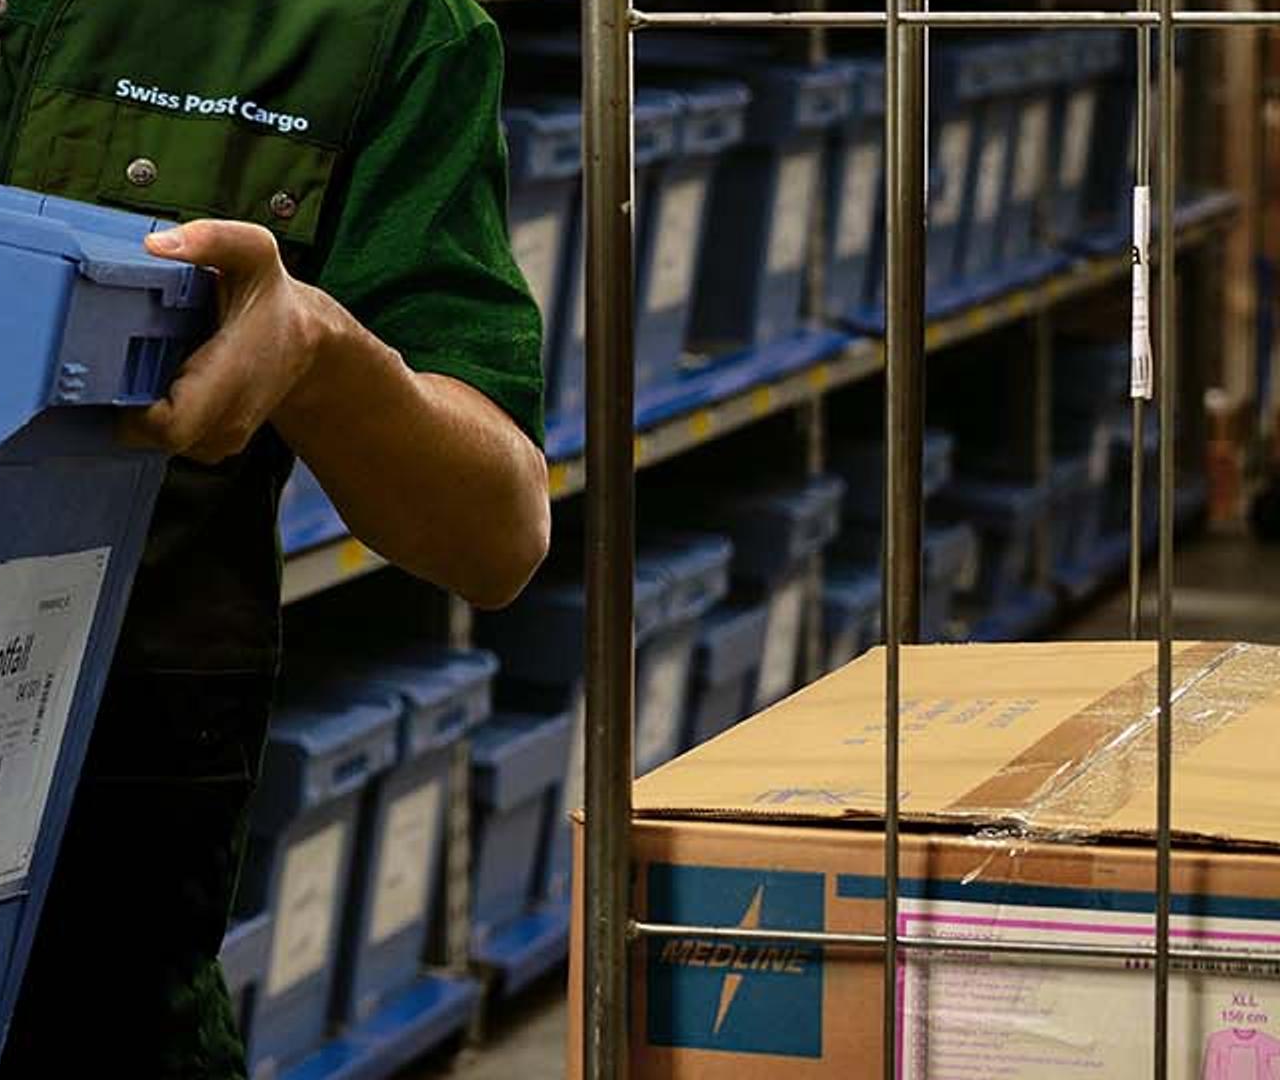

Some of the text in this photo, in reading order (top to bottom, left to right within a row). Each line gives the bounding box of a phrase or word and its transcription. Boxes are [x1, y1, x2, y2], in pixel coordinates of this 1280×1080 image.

[115, 78, 309, 132] Swiss Post Cargo
[662, 938, 808, 973] MEDLINE
[1246, 1013, 1268, 1024] cm
